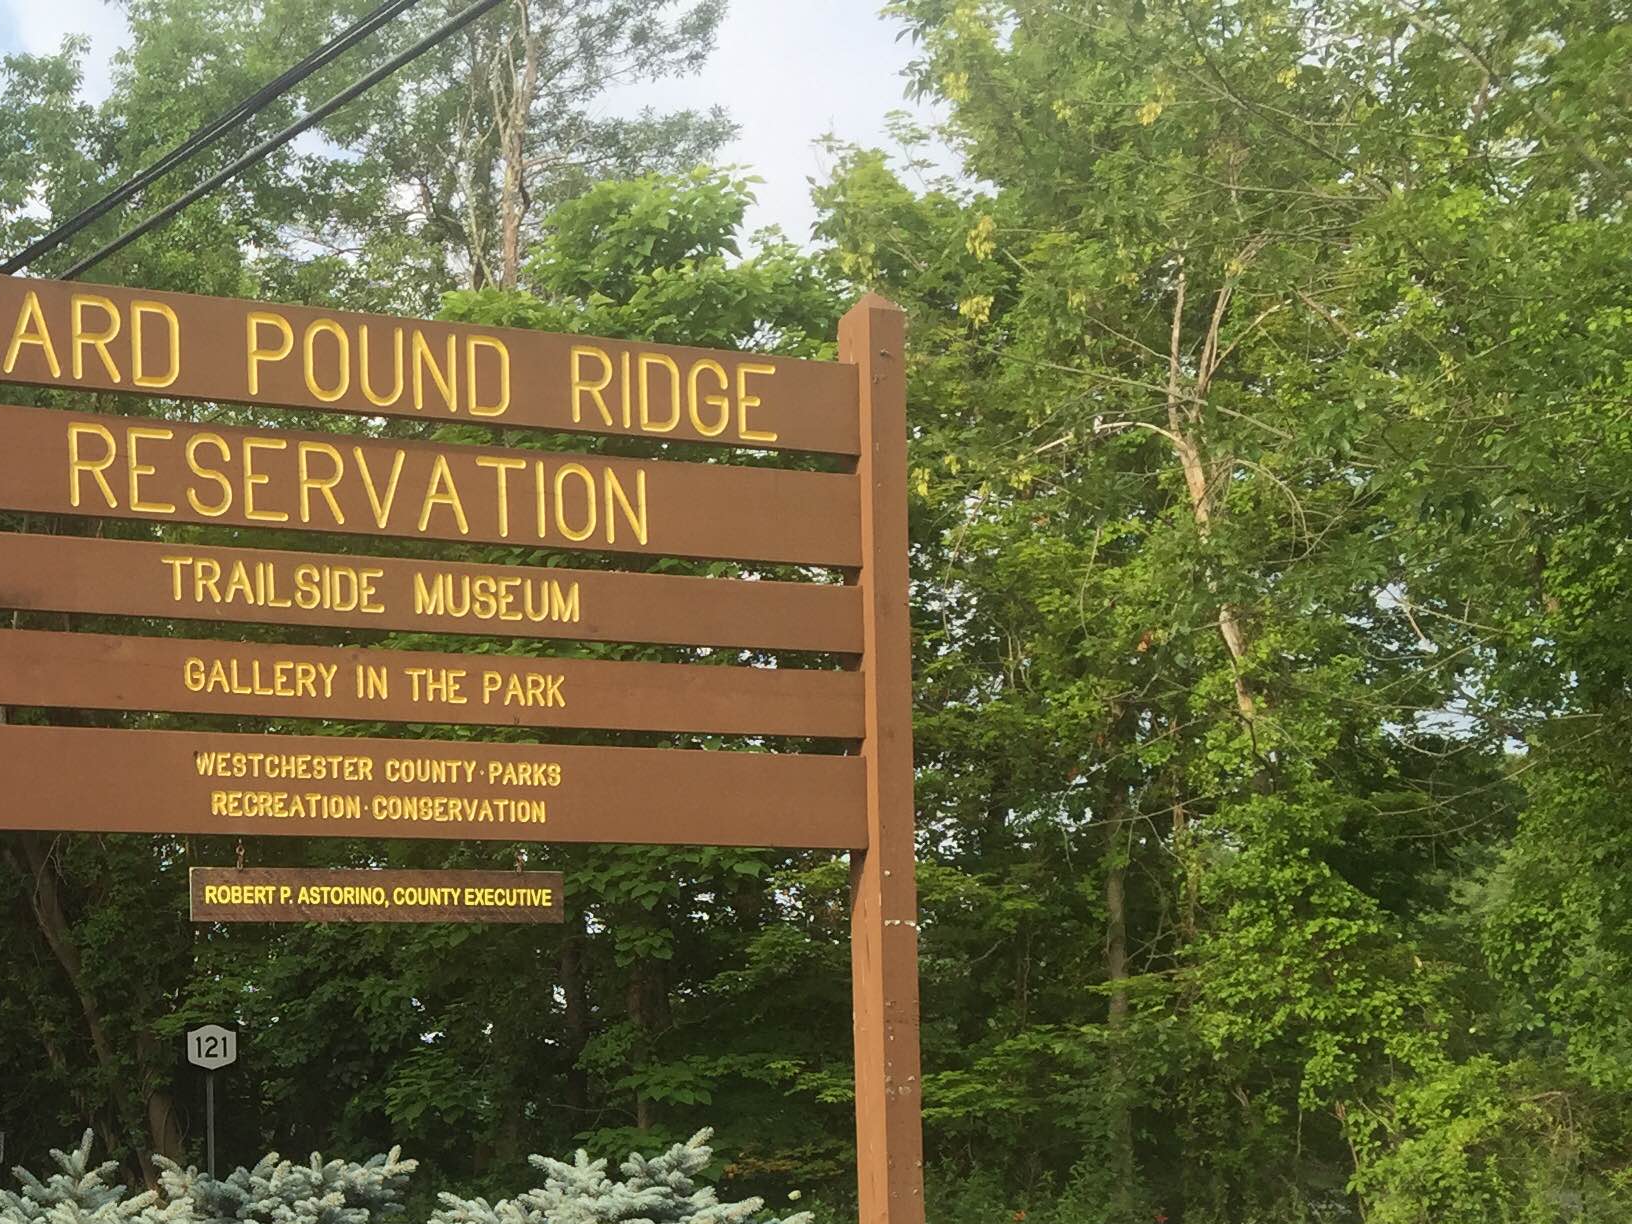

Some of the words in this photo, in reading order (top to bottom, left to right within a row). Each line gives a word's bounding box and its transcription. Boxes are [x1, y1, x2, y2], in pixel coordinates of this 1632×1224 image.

[246, 312, 512, 418] POUND
[570, 344, 780, 444] RIDGE
[67, 422, 650, 546] RESERVATION
[160, 555, 385, 614] TRAILSIDE
[414, 573, 581, 624] MUSEUM
[183, 656, 338, 699] GALLERY
[356, 664, 388, 700] IN
[404, 667, 468, 705] THE
[482, 670, 567, 708] PARK
[195, 751, 374, 782] WESTCHESTER
[205, 885, 276, 905] ROBERT
[280, 887, 293, 906] P.
[297, 886, 390, 908] ASTORINO,
[393, 887, 461, 906] COUNTY
[464, 888, 552, 907] EXECUTIVE
[196, 1036, 227, 1058] 121
